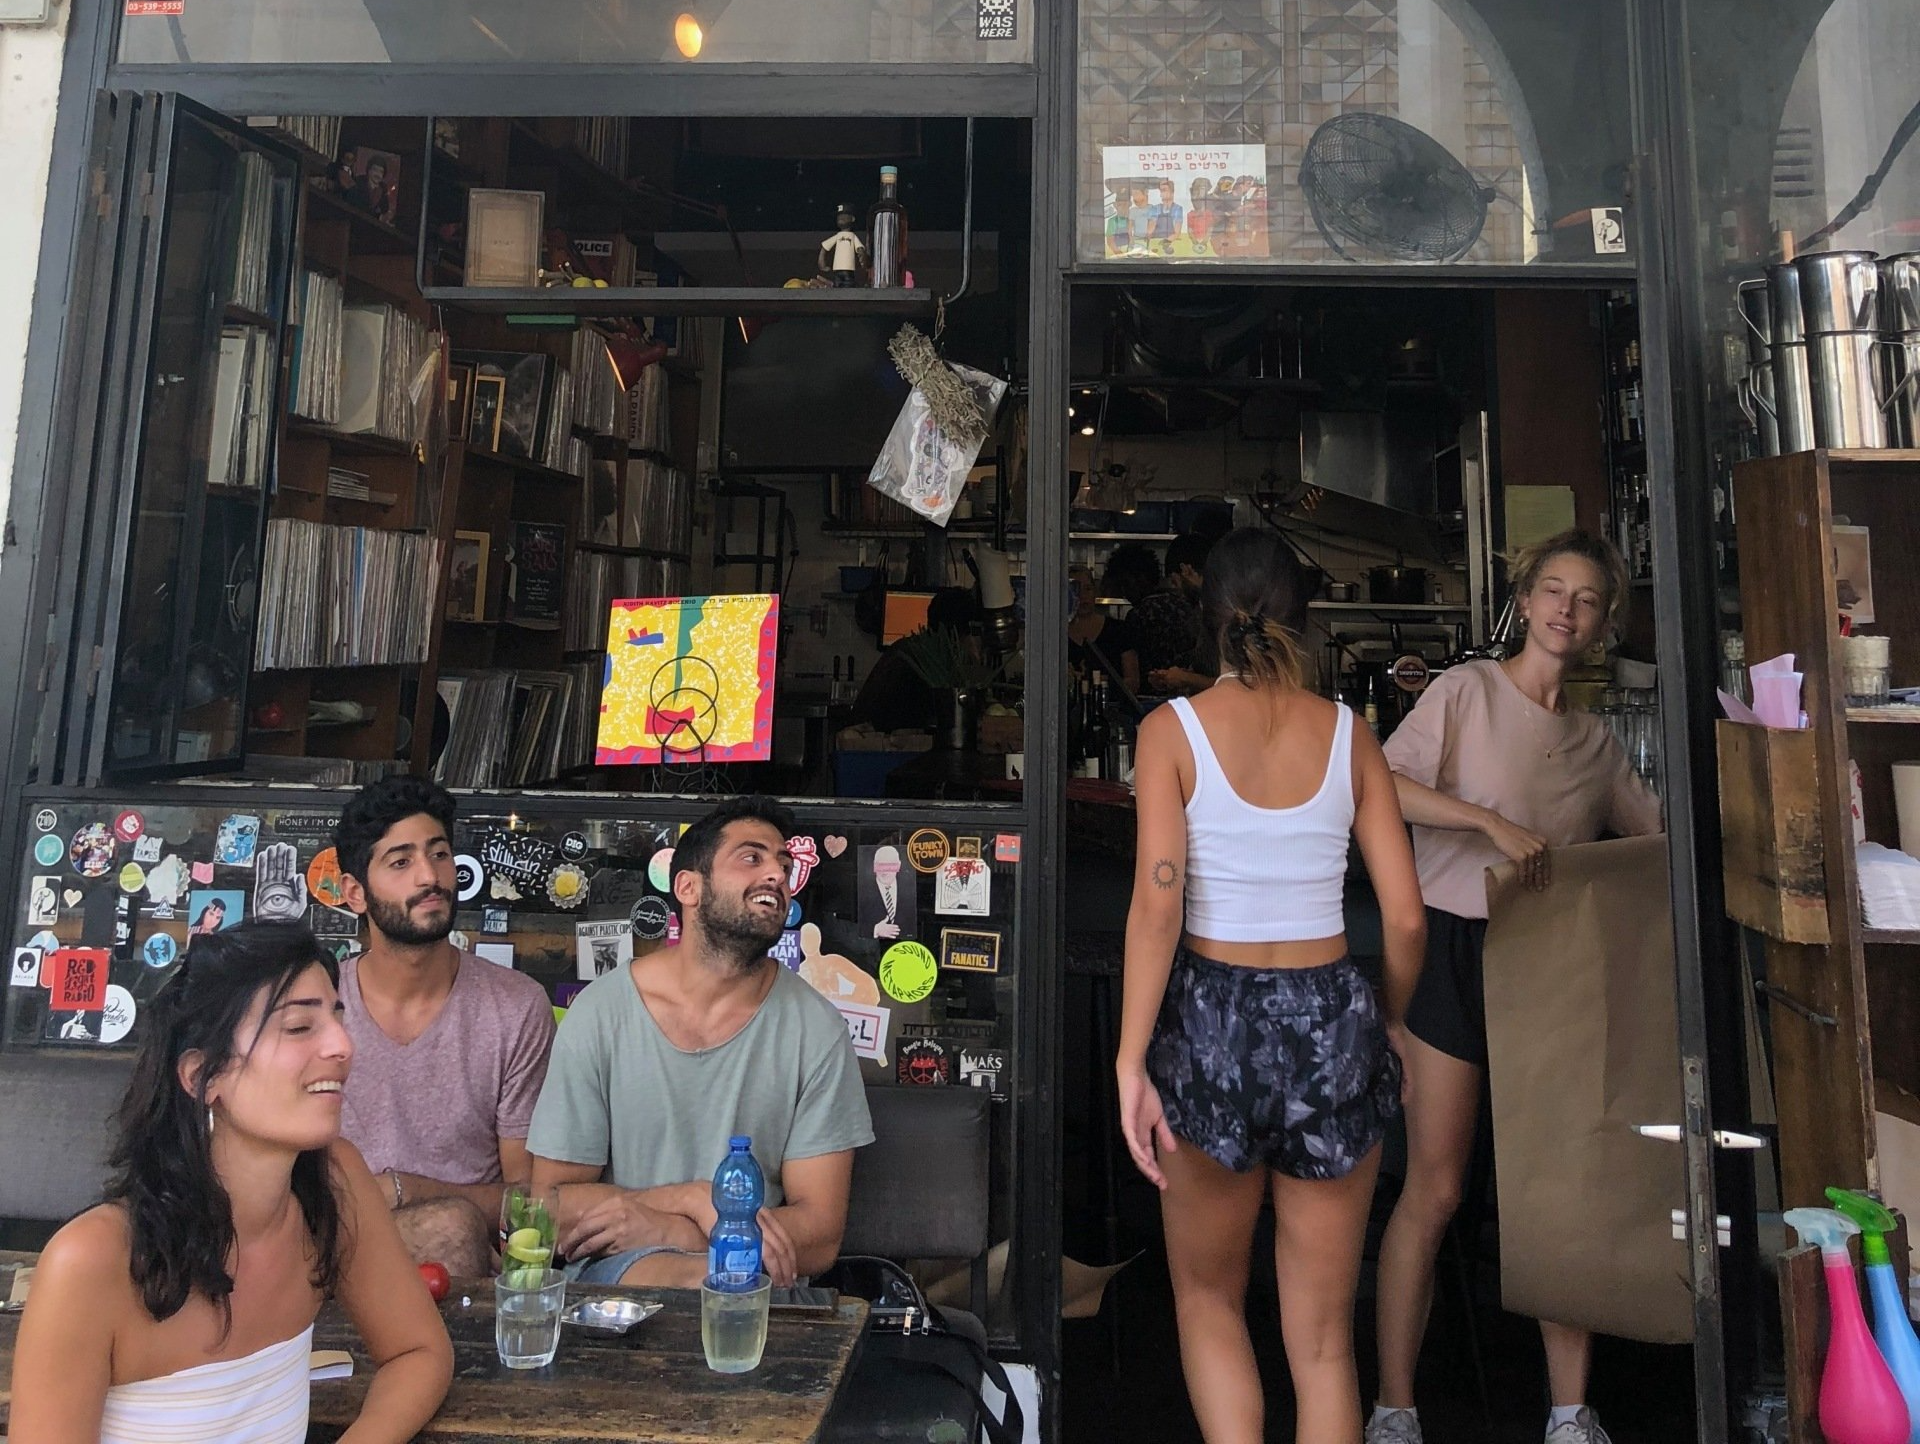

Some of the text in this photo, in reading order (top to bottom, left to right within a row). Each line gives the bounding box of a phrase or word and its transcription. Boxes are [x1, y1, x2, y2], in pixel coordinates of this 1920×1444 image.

[128, 2, 182, 11] 03-539-5555
[979, 16, 1014, 28] WAS
[979, 28, 1014, 38] HERE
[1138, 151, 1230, 161] דרושים טבחים
[1189, 161, 1227, 171] פרטים
[573, 242, 610, 253] OLICE
[279, 818, 309, 827] HONEY
[565, 837, 584, 851] DIG
[912, 840, 945, 852] FUNKY
[136, 848, 159, 861] TAPES
[913, 849, 944, 862] TOWN
[578, 925, 599, 938] AGAINST
[600, 924, 618, 937] PLASTIC
[893, 944, 932, 970] SOUND
[950, 951, 990, 967] FANATICS
[882, 960, 935, 1001] METAPHORS
